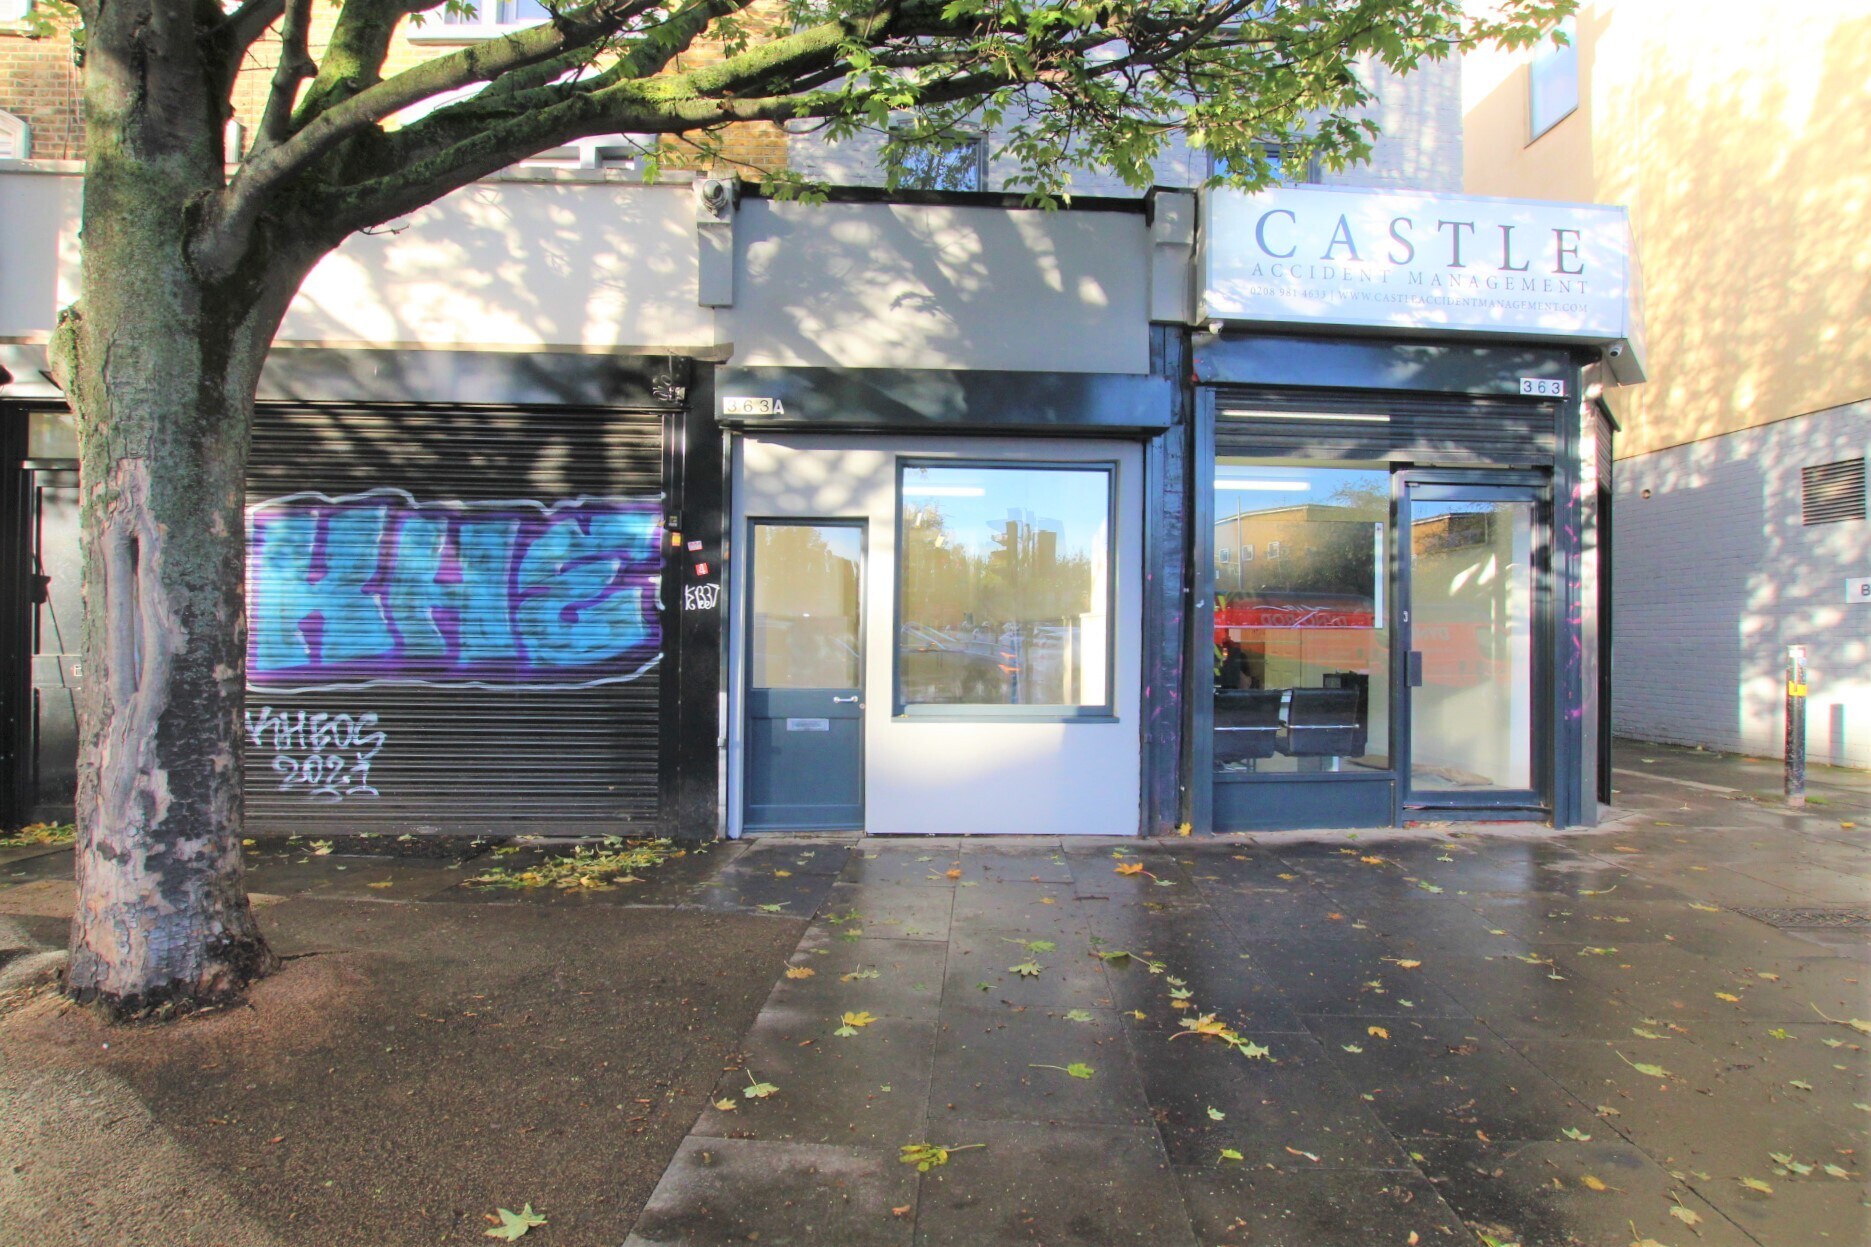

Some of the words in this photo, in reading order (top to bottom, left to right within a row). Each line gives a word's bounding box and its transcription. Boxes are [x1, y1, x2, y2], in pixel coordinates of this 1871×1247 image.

[1255, 209, 1585, 274] CASTLE
[1251, 262, 1391, 284] ACCIDENT
[1408, 271, 1590, 295] MANAGEMENT
[1250, 286, 1276, 297] 0208
[1279, 288, 1298, 298] 981
[1523, 380, 1561, 395] 363
